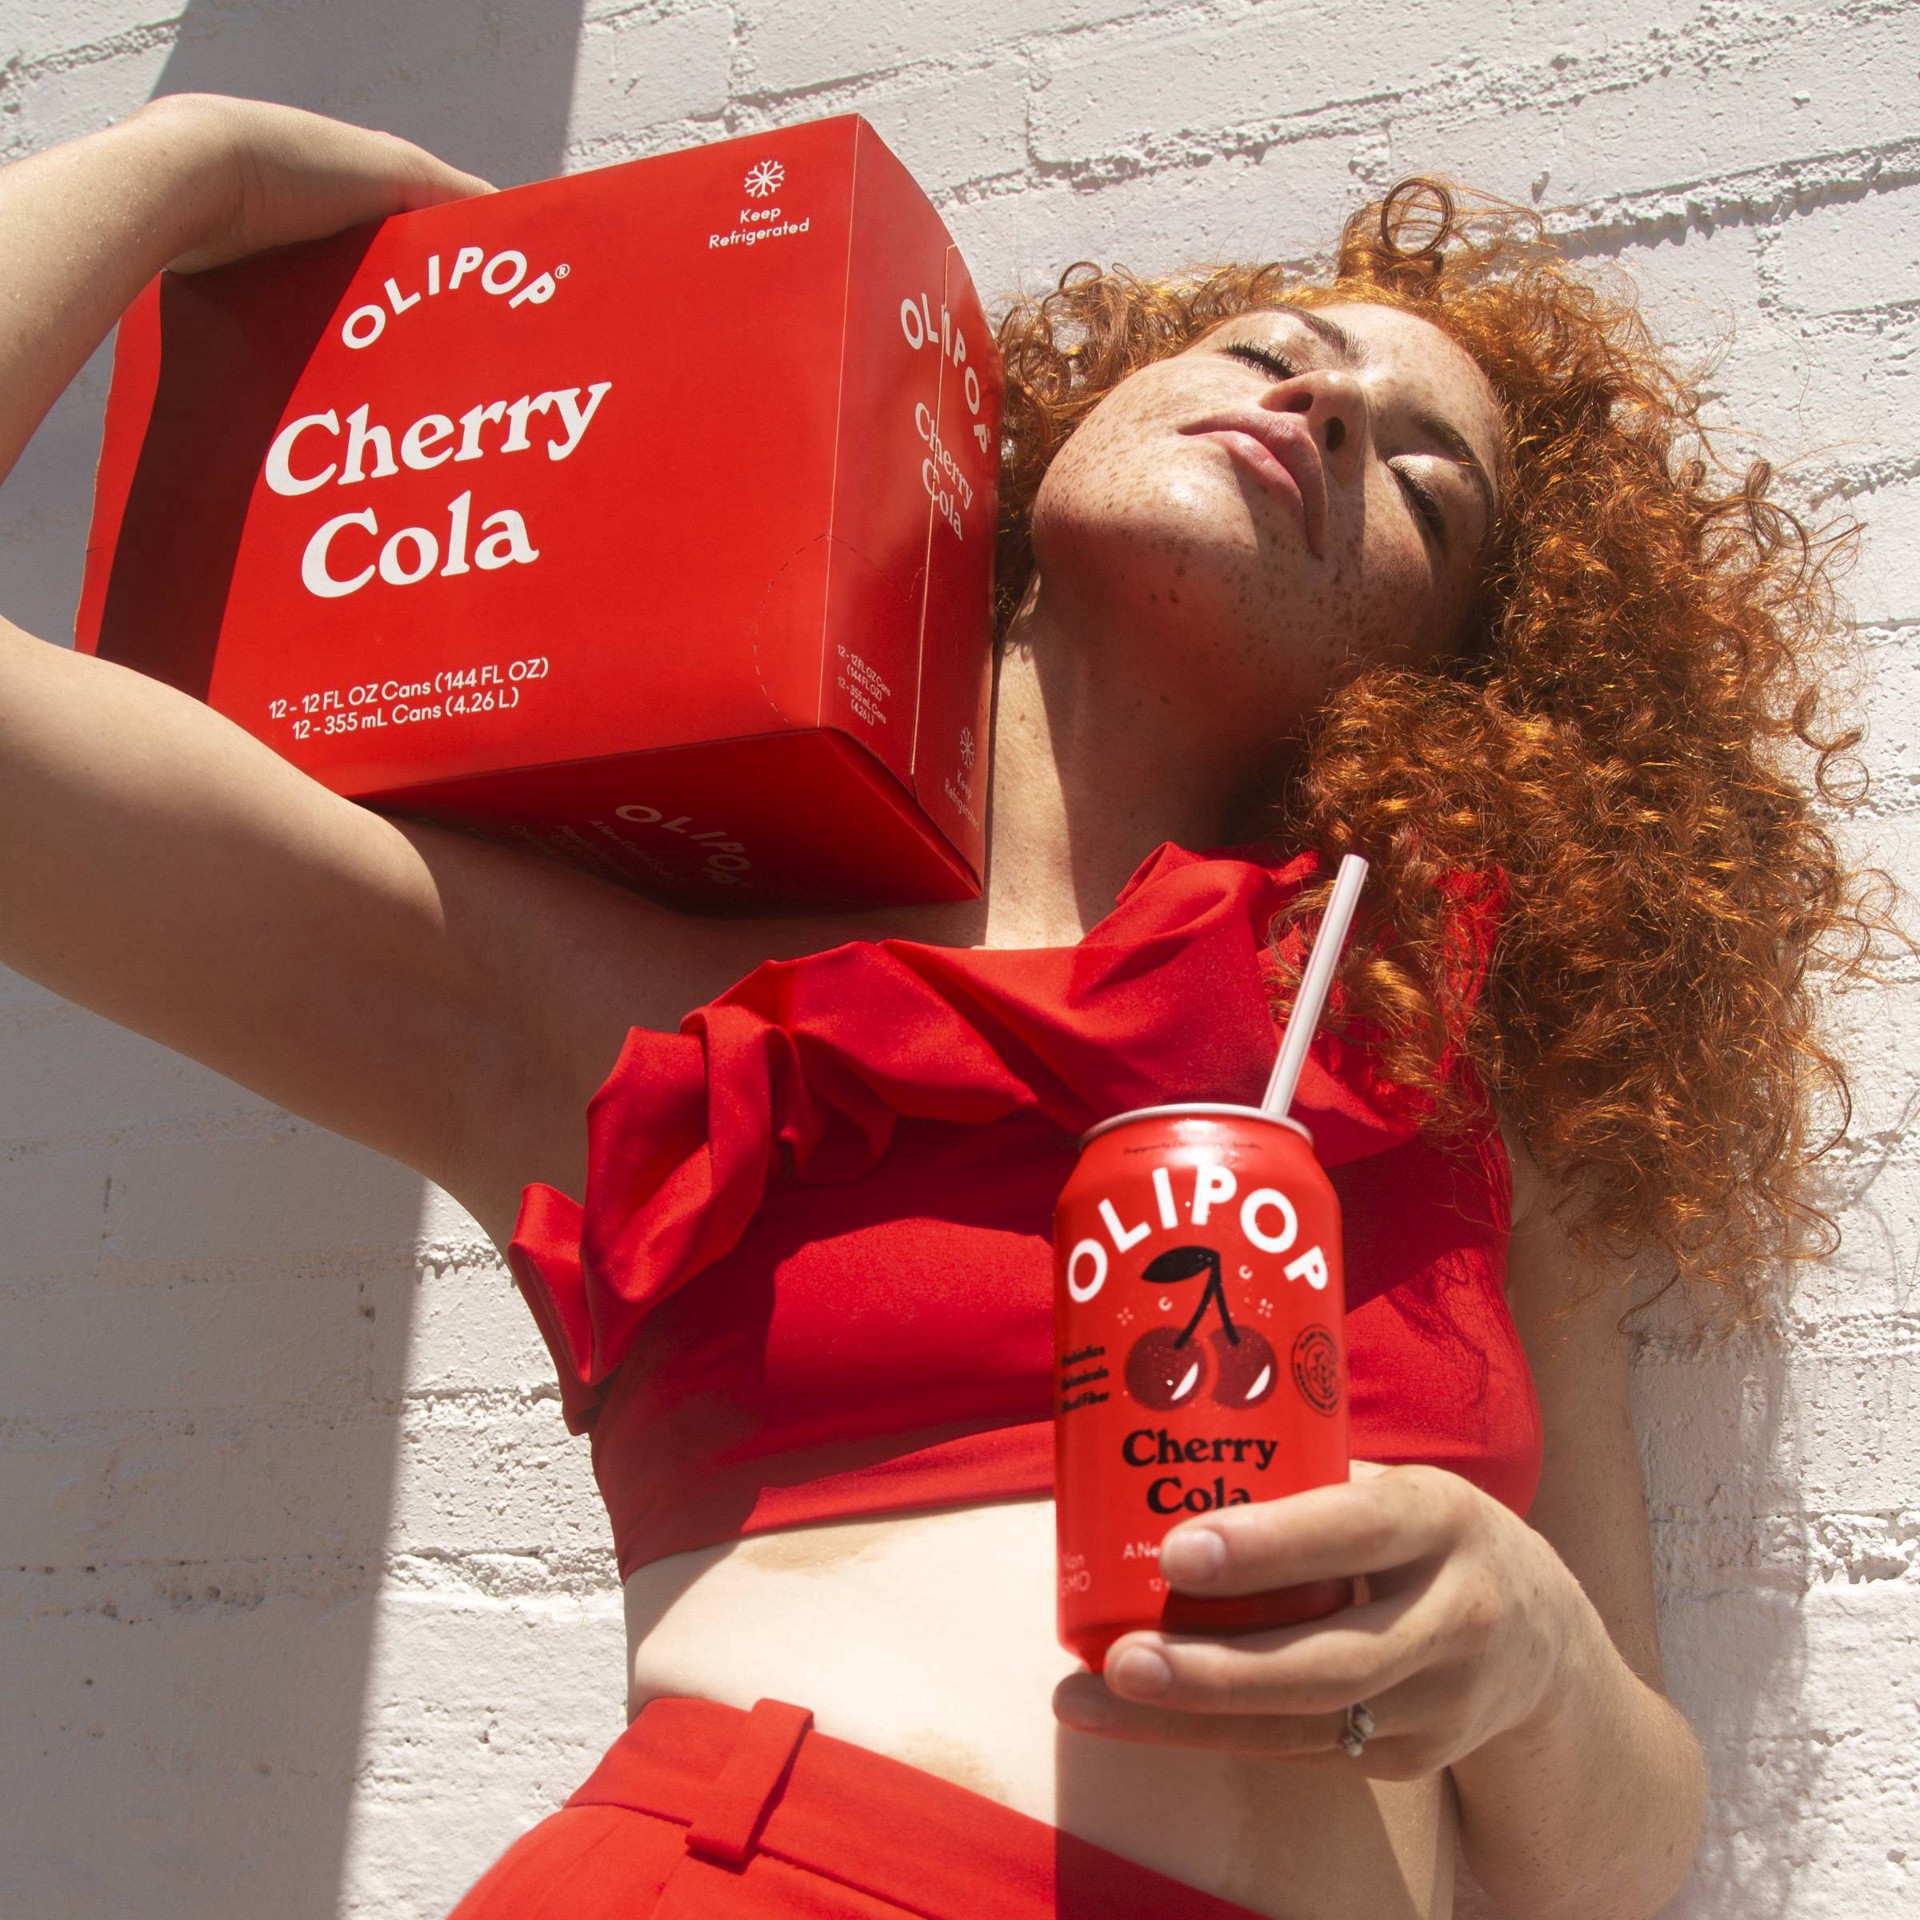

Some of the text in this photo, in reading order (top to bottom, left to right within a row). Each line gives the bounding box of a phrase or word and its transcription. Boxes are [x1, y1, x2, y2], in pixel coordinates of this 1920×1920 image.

[709, 217, 810, 249] Refrigerated
[740, 207, 781, 224] Keep
[264, 381, 612, 496] Cherry
[915, 402, 973, 510] Cherry
[922, 458, 962, 541] Cola
[301, 490, 539, 598] Cola
[268, 699, 286, 719] 12
[301, 693, 319, 714] 12
[323, 690, 344, 711] FL
[349, 683, 378, 706] OZ
[381, 680, 431, 701] Cans
[435, 670, 477, 694] (144
[481, 665, 504, 686] FL
[508, 656, 549, 681] OZ)
[866, 667, 877, 683] OZ
[292, 720, 310, 740] 12
[324, 712, 358, 735] 355
[361, 708, 388, 729] mL
[391, 703, 441, 724] Cans
[445, 690, 495, 717] (4.26
[498, 686, 519, 709] L)
[1068, 1165, 1328, 1303] OLIPOP
[1122, 1429, 1279, 1470] Cherry
[1137, 1541, 1161, 1558] Ne
